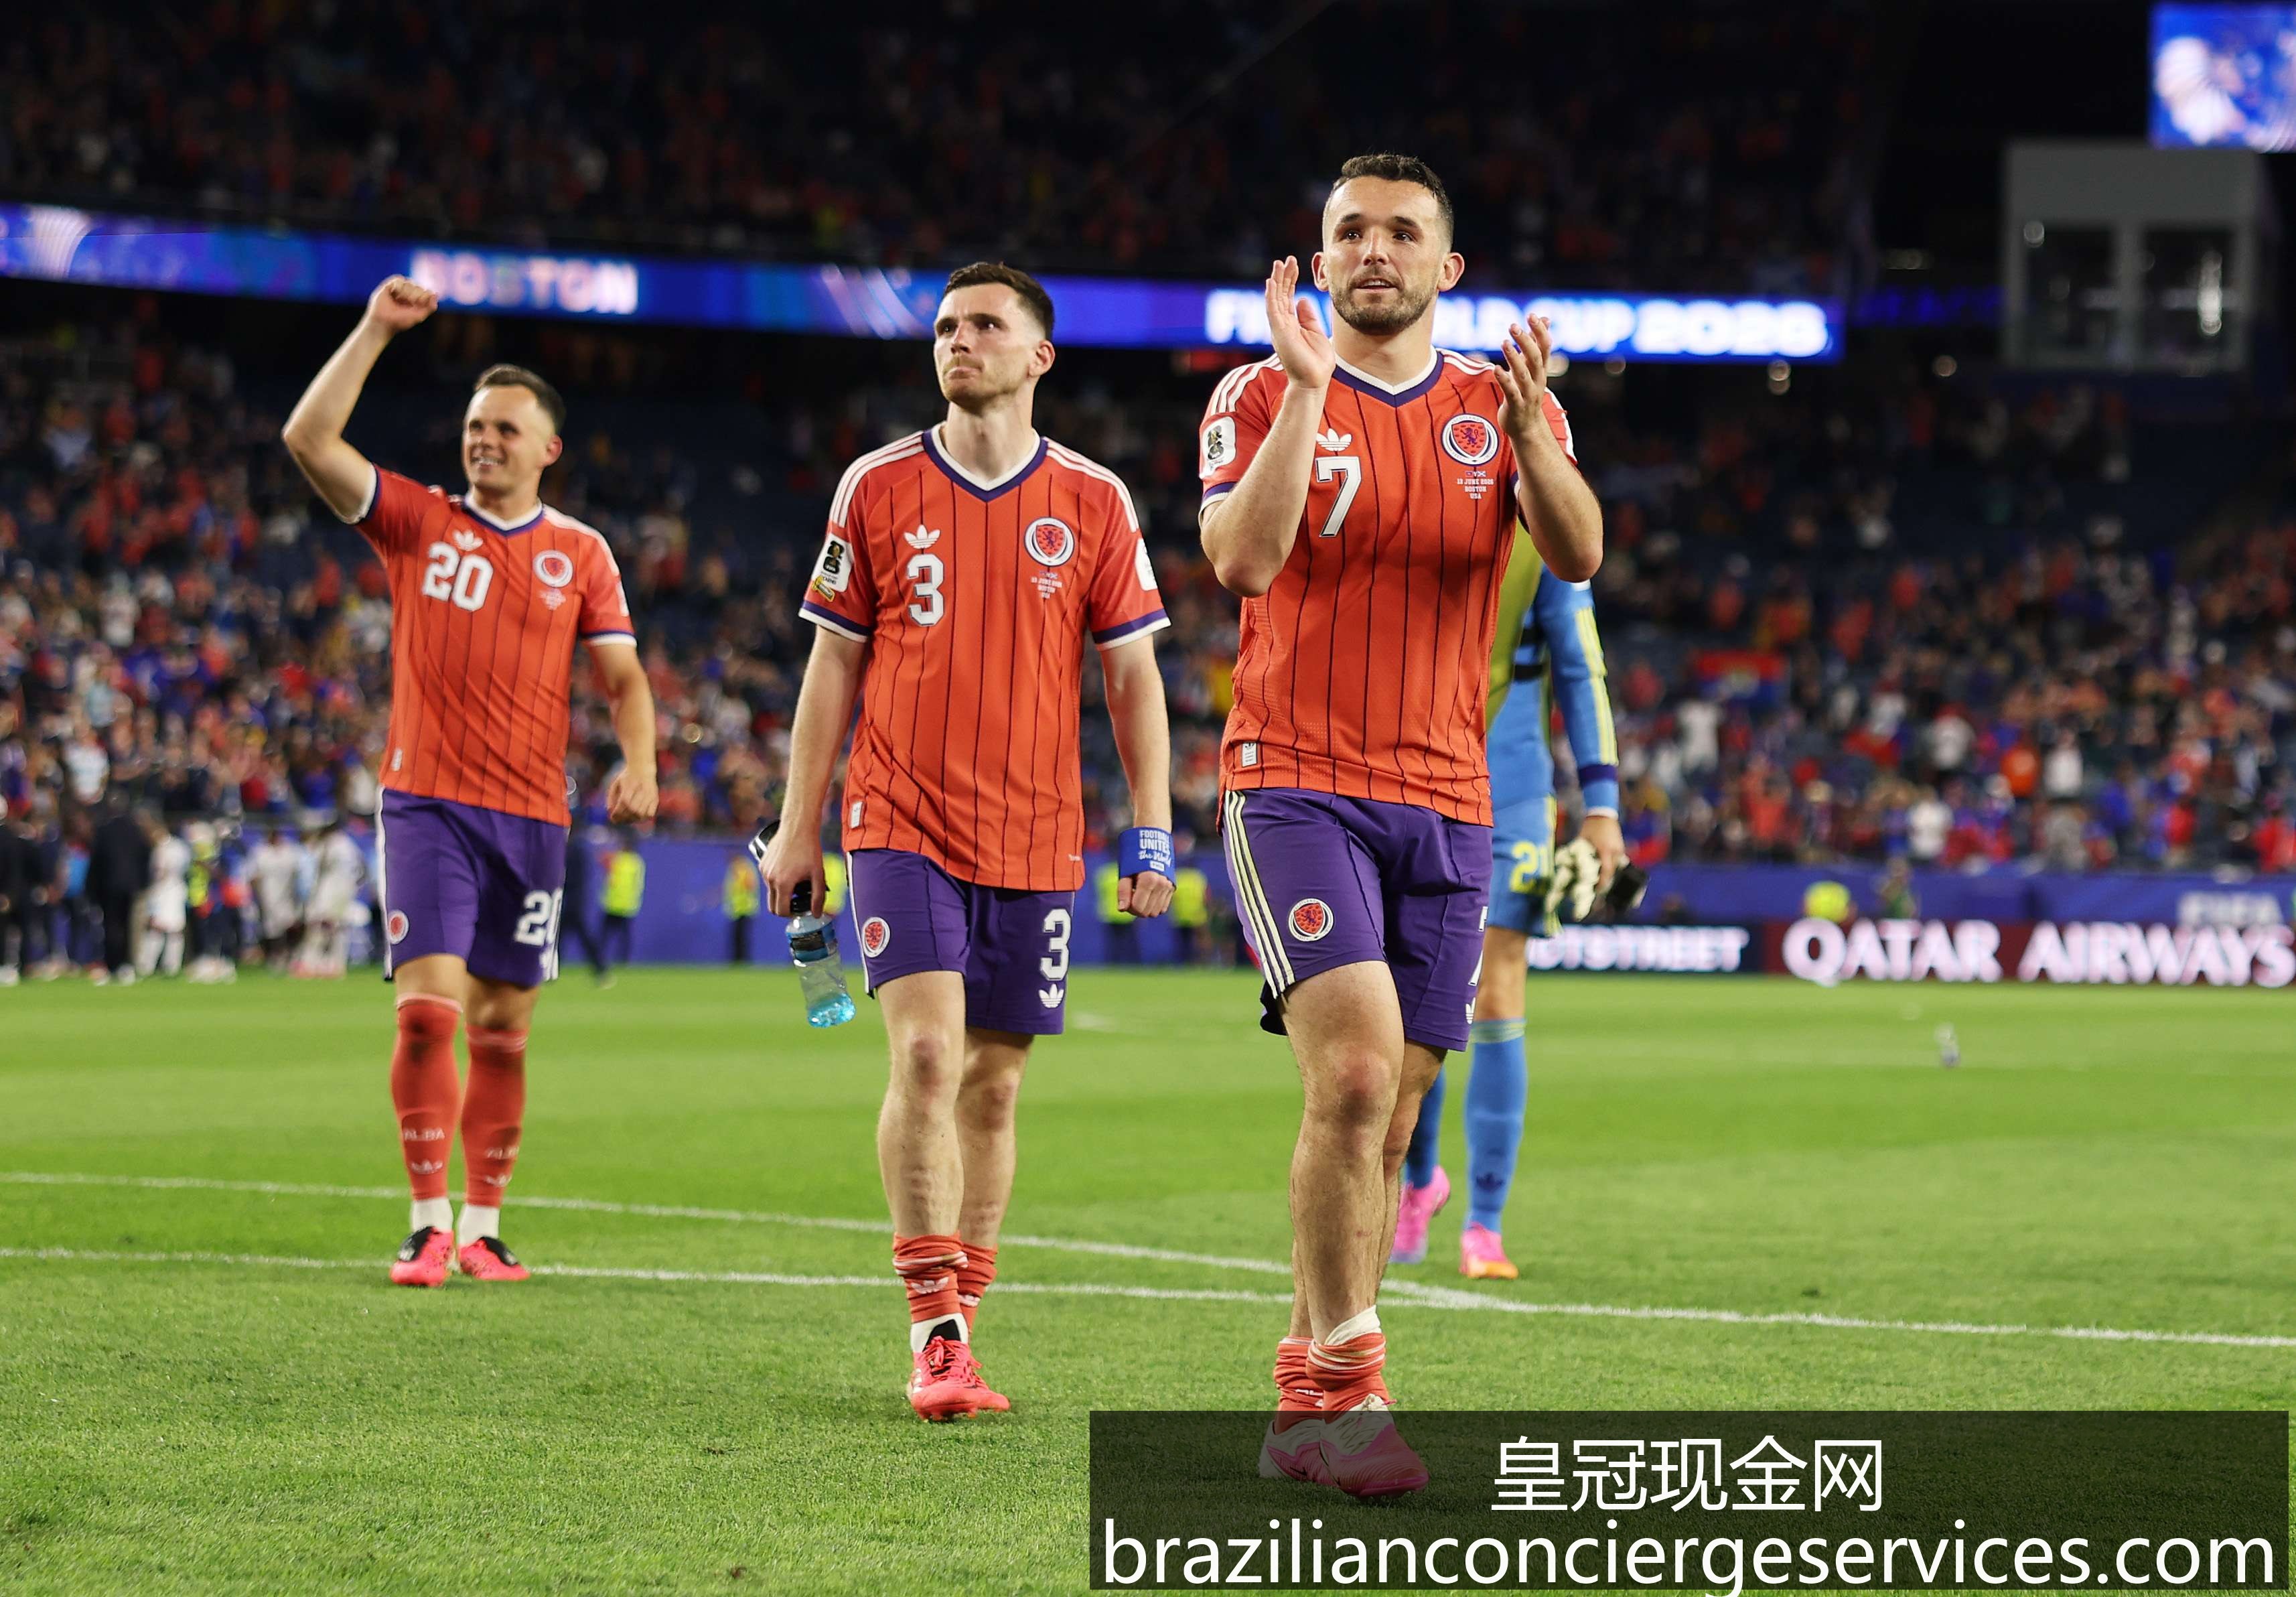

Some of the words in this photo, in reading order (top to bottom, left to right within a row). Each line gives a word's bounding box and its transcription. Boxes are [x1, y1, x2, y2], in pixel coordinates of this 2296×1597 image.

[1633, 299, 1828, 356] 2026
[1315, 456, 1361, 538] 7
[422, 541, 494, 612] 20
[908, 553, 945, 627] 3
[1039, 908, 1072, 981] 3
[1782, 916, 2003, 987] QATAR
[2017, 920, 2295, 988] AIRWAYS
